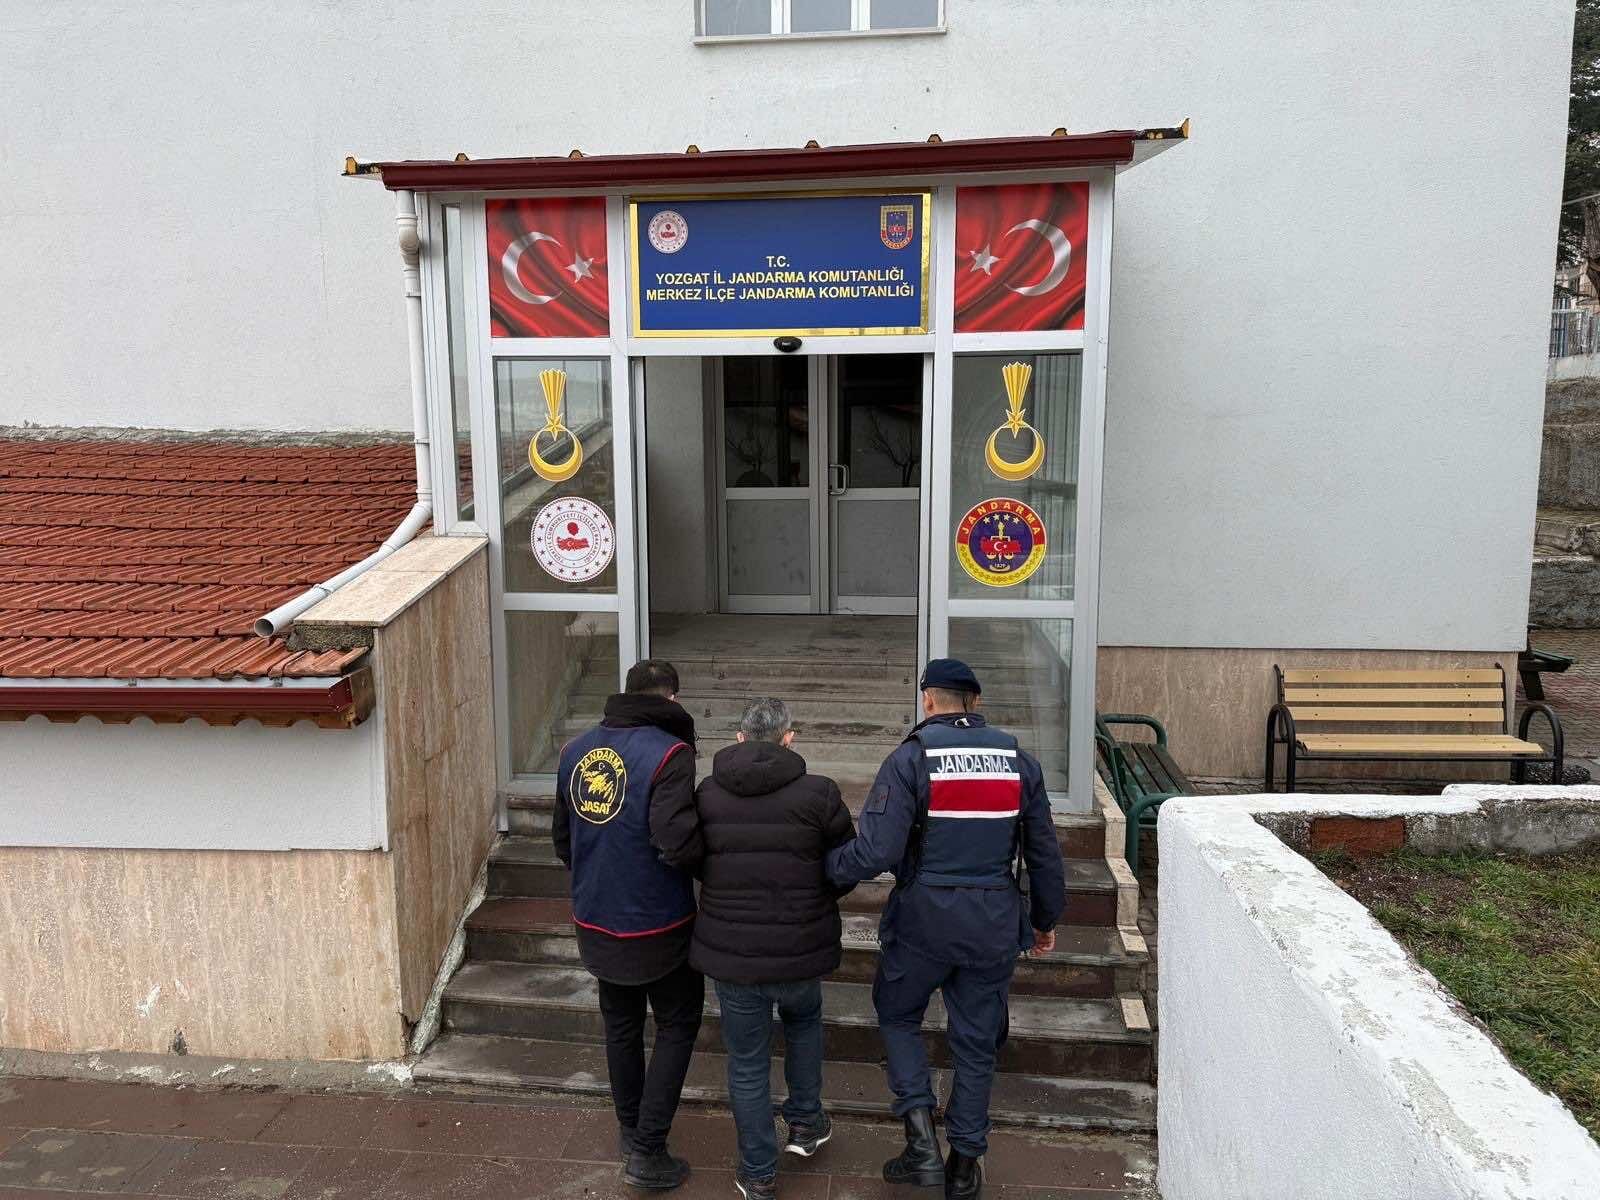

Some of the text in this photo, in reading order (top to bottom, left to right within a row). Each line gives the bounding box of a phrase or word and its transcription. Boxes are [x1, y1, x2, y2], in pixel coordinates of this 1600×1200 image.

[766, 256, 790, 268] T.C.
[656, 266, 904, 285] YOZGAT İL JANDARMA KOMUTANLIĞI
[646, 281, 914, 303] MERKEZ İLÇE JANDARMA KOMUTANLIĞI
[962, 502, 1041, 535] JANDARMA
[580, 750, 624, 777] JANDARMA
[936, 754, 1013, 773] JANDARMA
[581, 800, 612, 815] JASAT
